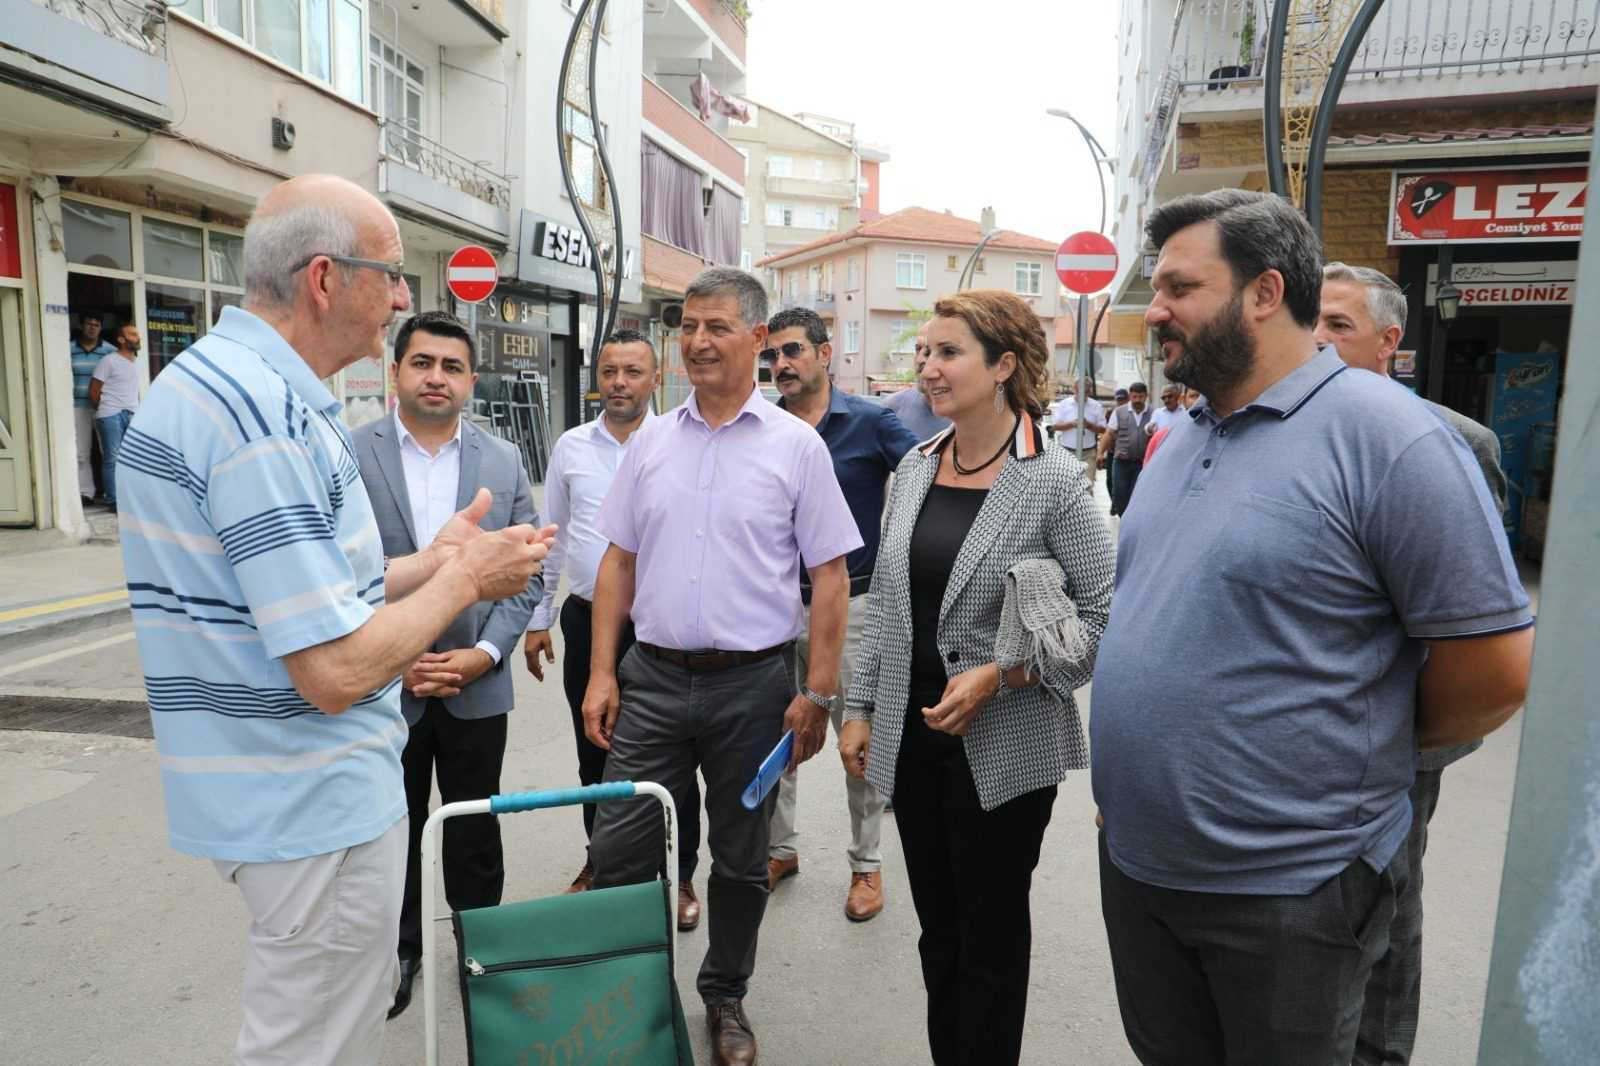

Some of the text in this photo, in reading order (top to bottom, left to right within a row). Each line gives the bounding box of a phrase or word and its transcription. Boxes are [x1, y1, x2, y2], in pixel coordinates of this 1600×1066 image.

[1453, 182, 1588, 220] LEZ
[1485, 222, 1548, 235] Cemiyet
[503, 332, 538, 357] ESEN
